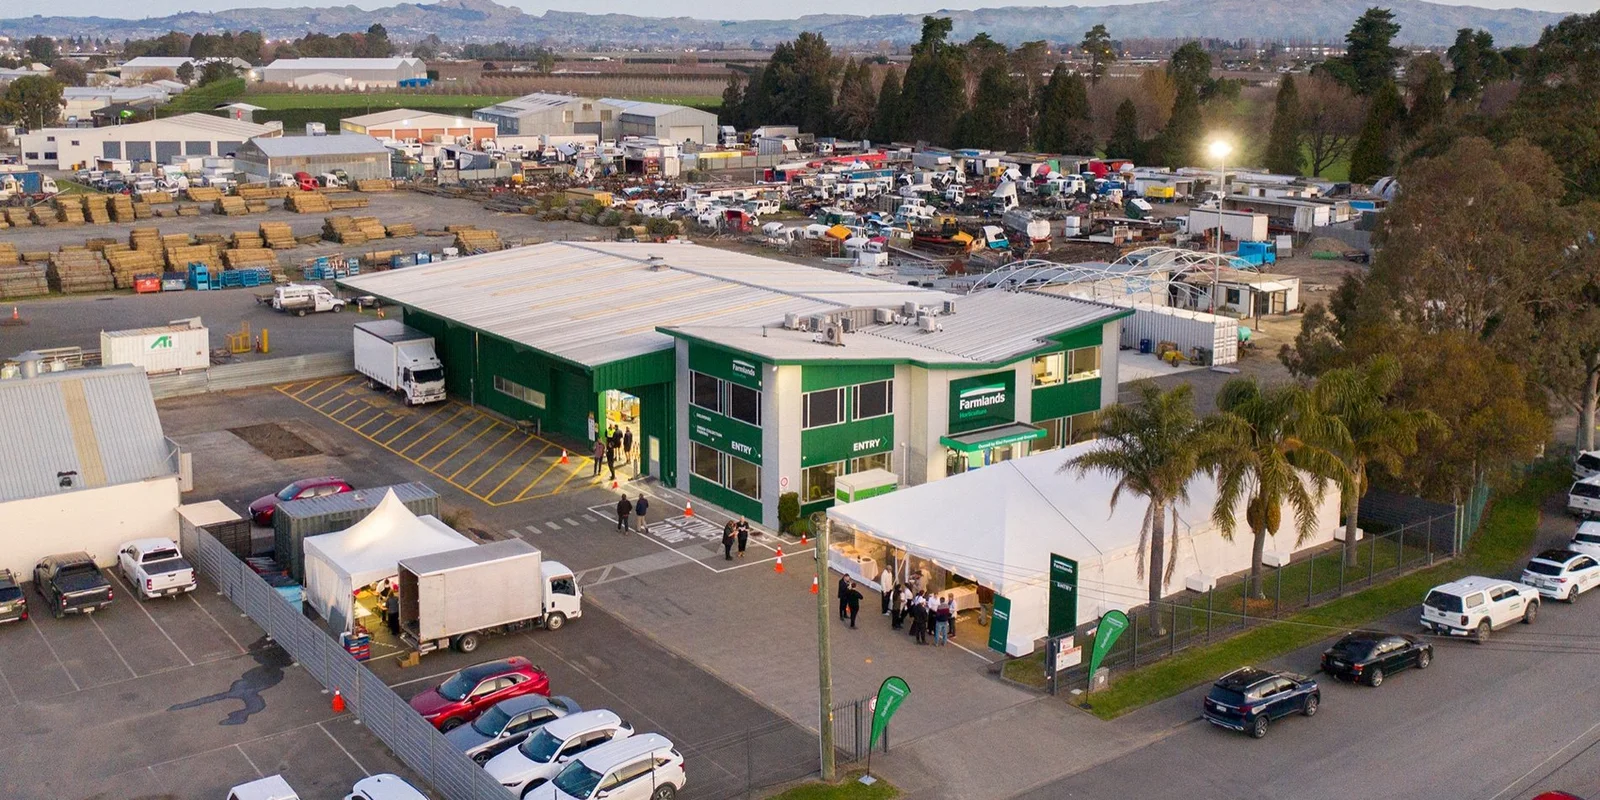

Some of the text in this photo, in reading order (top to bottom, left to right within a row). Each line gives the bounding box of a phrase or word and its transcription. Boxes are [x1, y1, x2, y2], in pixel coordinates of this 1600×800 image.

[959, 392, 1006, 410] Farmlands
[731, 440, 752, 455] ENTRY
[853, 438, 881, 451] ENTRY
